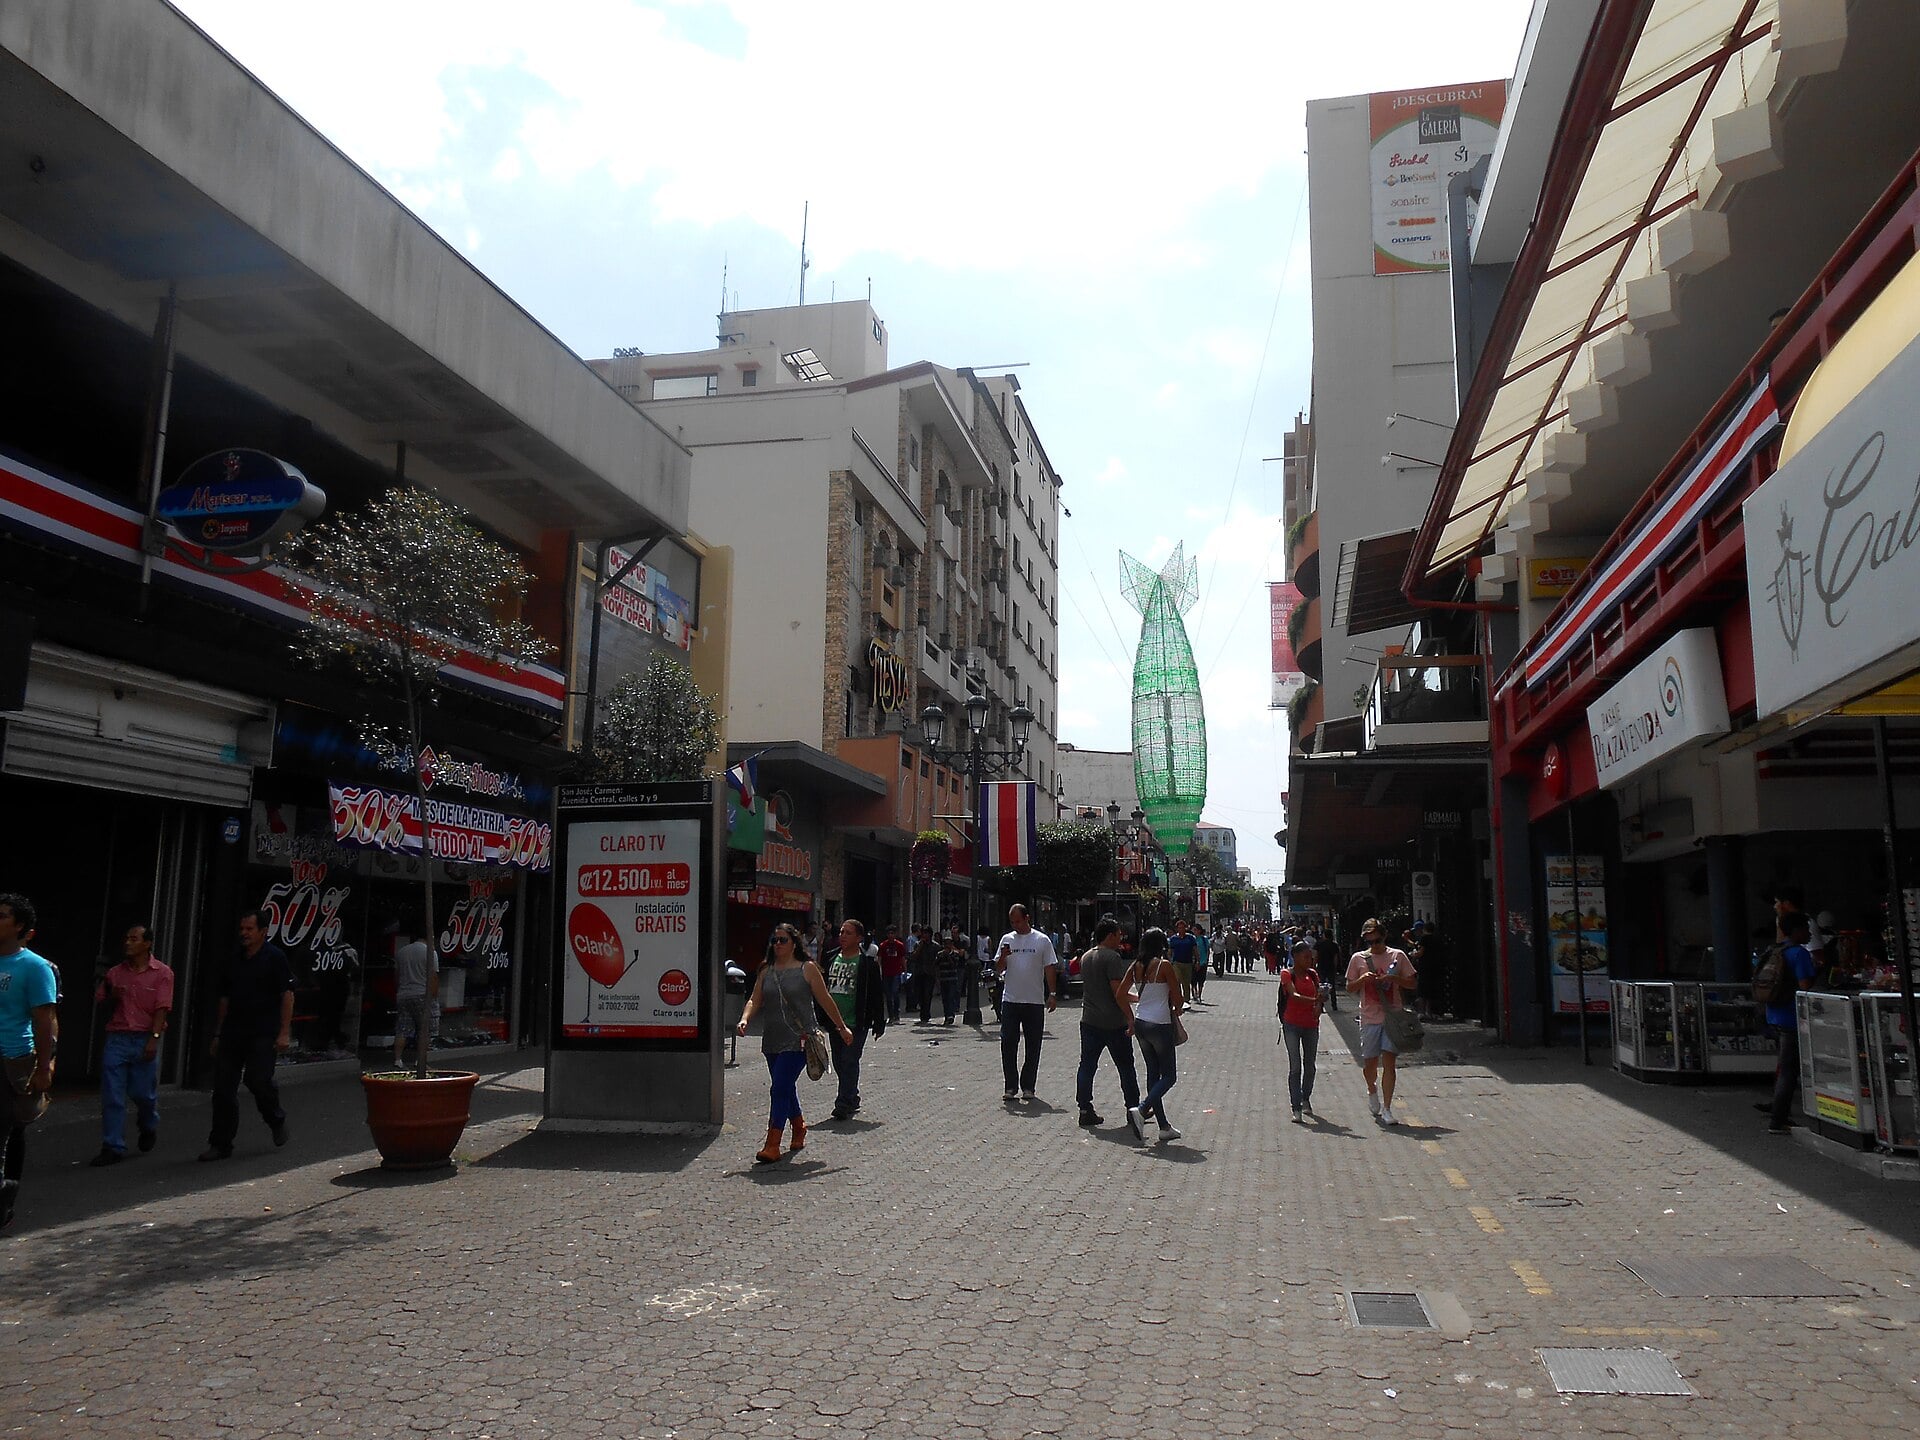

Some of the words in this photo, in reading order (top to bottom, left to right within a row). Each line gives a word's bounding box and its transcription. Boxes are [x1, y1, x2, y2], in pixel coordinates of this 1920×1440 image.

[1393, 88, 1482, 109] ¡DESCUBRA!
[1422, 112, 1430, 121] La
[1391, 235, 1432, 244] OLYMPUS
[608, 586, 648, 616] ABIERTO
[602, 596, 624, 617] NOW
[626, 607, 651, 632] OPEN
[561, 787, 575, 797] San
[619, 794, 638, 802] calles
[640, 793, 645, 801] 7
[646, 795, 651, 803] y
[652, 793, 658, 801] 9
[334, 786, 410, 848] 50%
[439, 803, 455, 822] DE
[456, 805, 469, 828] LA
[471, 808, 505, 834] PATRIA
[1424, 811, 1461, 824] FARMACIA
[431, 829, 467, 860] TODO
[469, 835, 487, 862] AL
[498, 818, 552, 870] 50%
[600, 835, 646, 852] CLARO
[648, 834, 666, 851] TV
[666, 869, 676, 880] al
[261, 883, 351, 950] 50%
[635, 902, 686, 914] Instalación
[440, 899, 509, 956] 50%
[635, 915, 687, 933] GRATIS
[574, 933, 614, 957] Claro
[312, 951, 344, 972] 30%
[487, 952, 509, 969] 30%
[660, 982, 686, 993] Claro
[606, 1001, 640, 1011] 7002-7002
[653, 1009, 673, 1018] Claro
